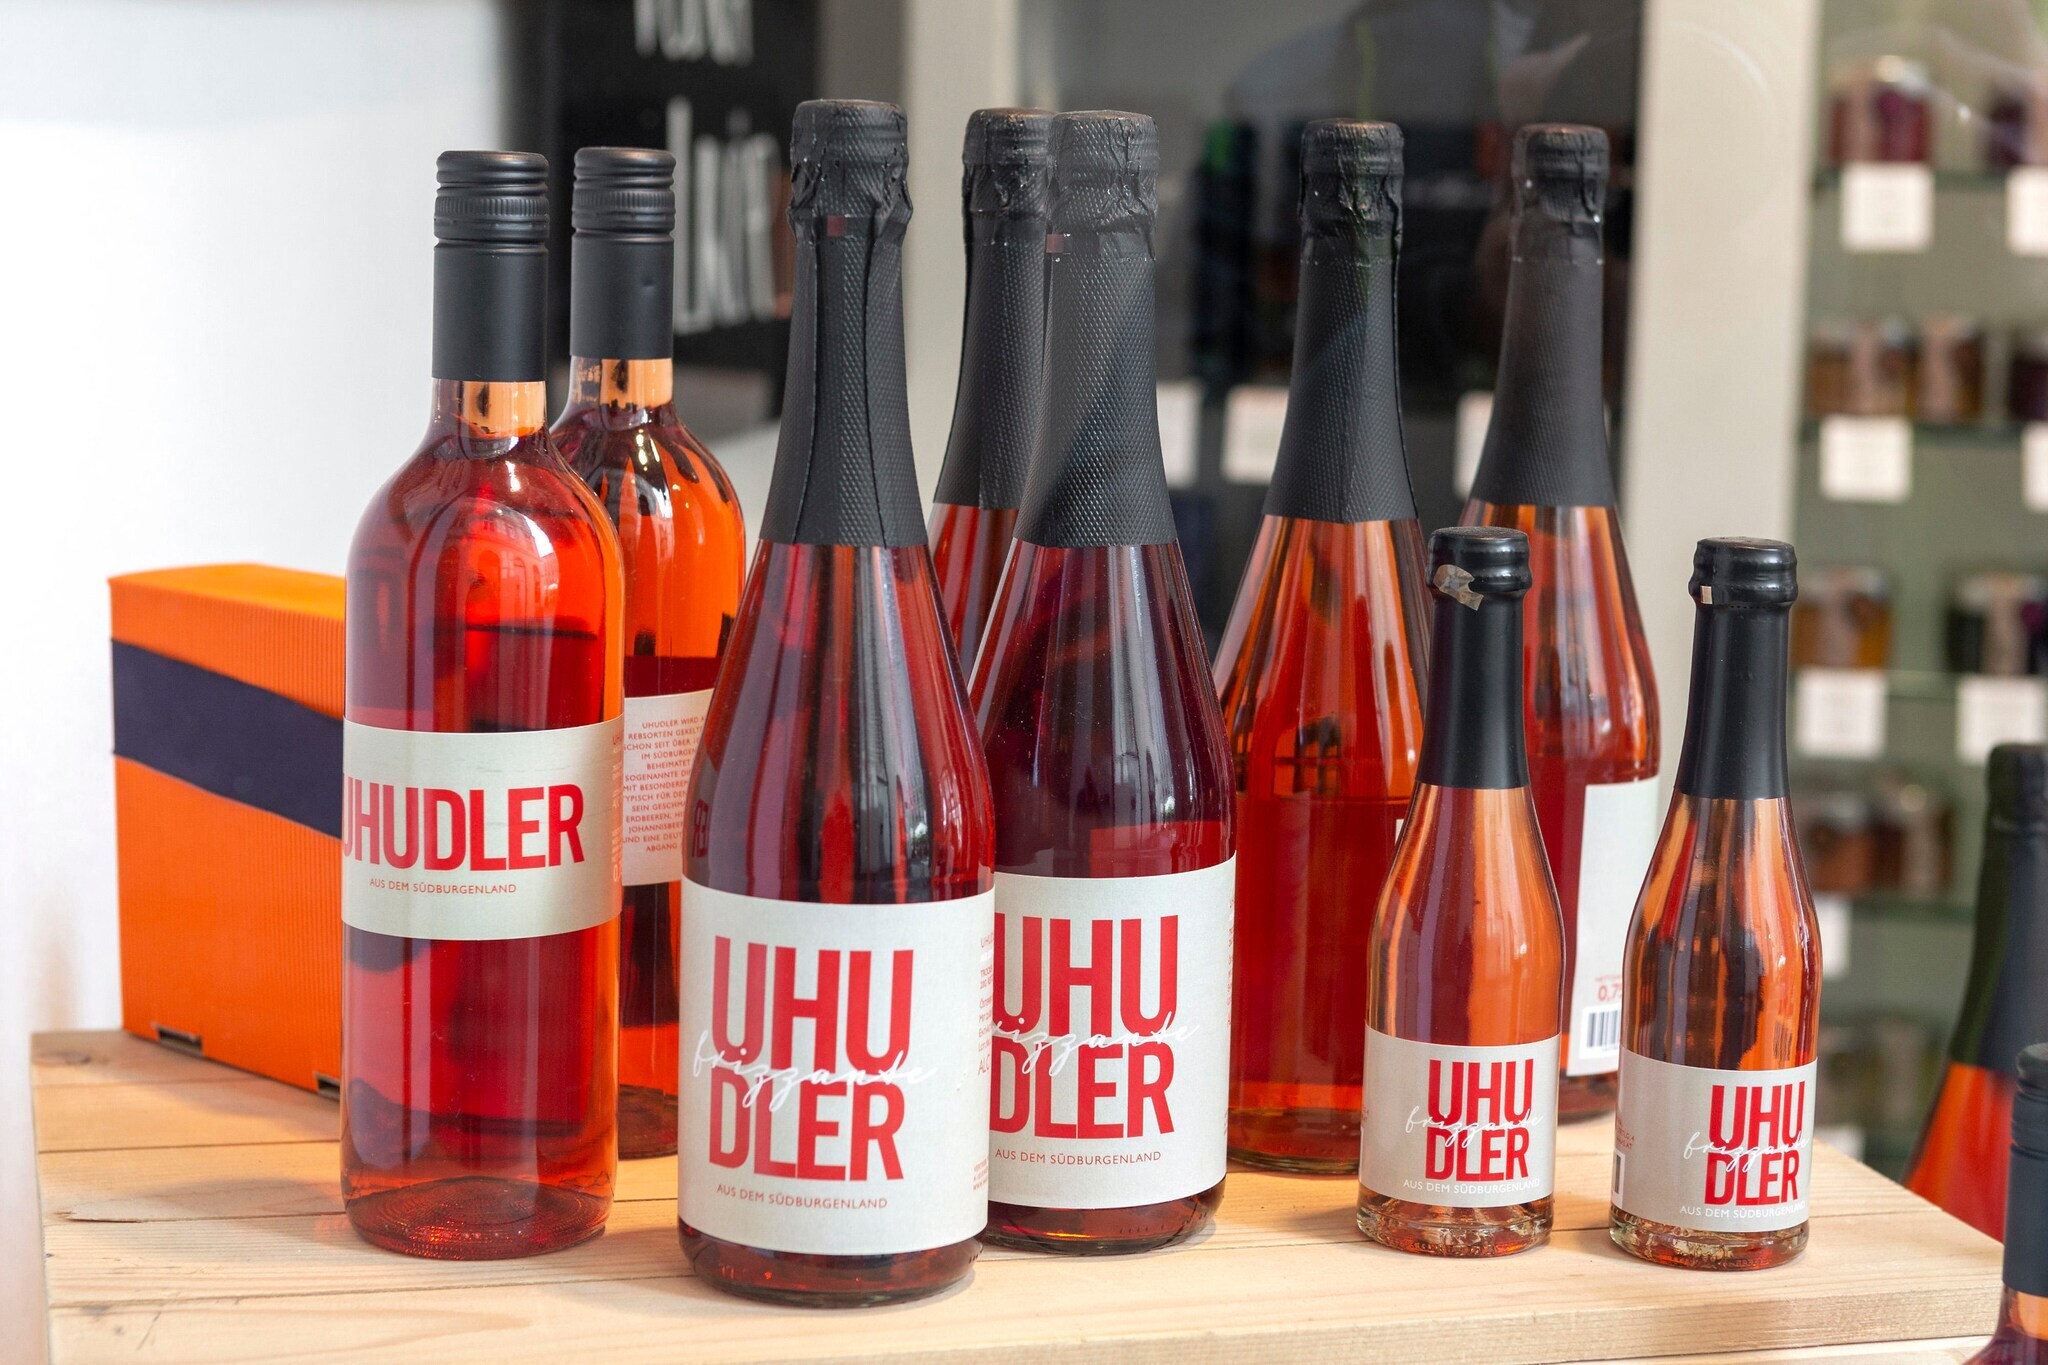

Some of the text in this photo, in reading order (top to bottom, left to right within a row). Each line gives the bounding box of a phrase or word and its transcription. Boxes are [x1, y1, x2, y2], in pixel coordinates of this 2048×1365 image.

[642, 720, 678, 729] UHUDLER
[681, 716, 698, 726] WIRD
[628, 731, 673, 740] REBSORTEN
[655, 741, 669, 749] SEIT
[672, 738, 690, 747] ÜBER
[647, 760, 691, 770] BEHEIMATET
[625, 771, 678, 781] SOGENANNTE
[656, 791, 671, 800] FÜR
[631, 804, 649, 812] SEIN
[342, 773, 585, 872] UHUDLER
[643, 834, 660, 842] EINE
[646, 841, 678, 852] ABGANG
[370, 878, 517, 894] AUS DEM SÜDBURGENLAND
[992, 912, 1179, 1038] UHU
[711, 936, 914, 1073] UHU
[693, 1030, 938, 1112] frizzante
[989, 1035, 1175, 1139] DLER
[1428, 1058, 1534, 1127] UHU
[709, 1066, 905, 1182] DLER
[1709, 1081, 1805, 1151] UHU
[1405, 1105, 1544, 1148] frizzante
[995, 1149, 1161, 1165] AUS DEM SÜDBURGENLAND
[1425, 1126, 1529, 1182] DLER
[1403, 1178, 1541, 1194] AUS DEM SÜDBURGENLAND
[1704, 1150, 1800, 1206] DLER
[716, 1184, 888, 1209] AUS DEM SÜDBURGENLAND
[1680, 1200, 1806, 1218] AUS DEM SÜDBURGENLAND
